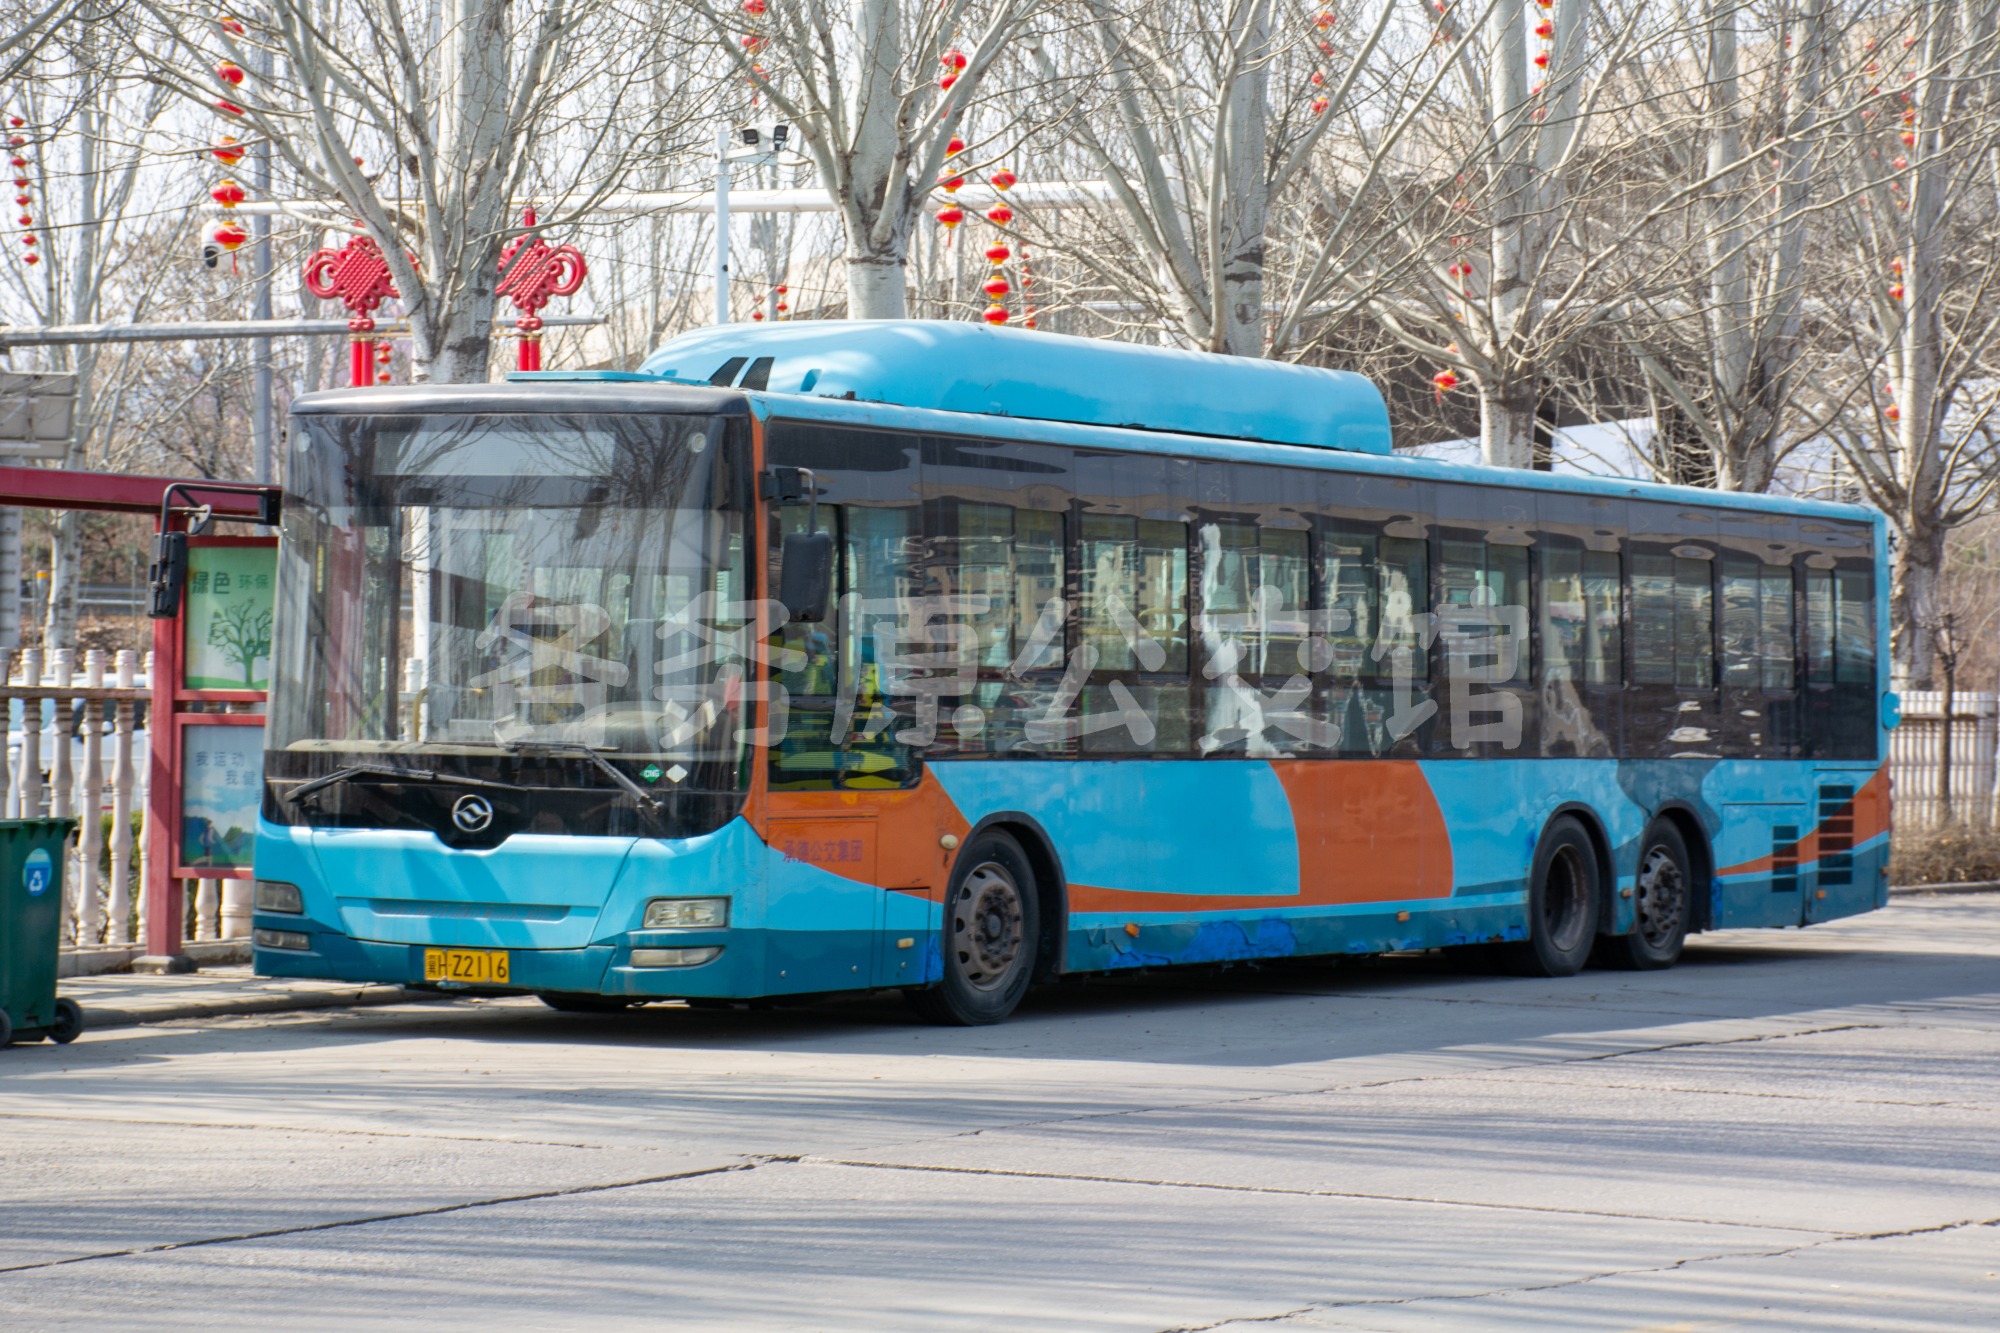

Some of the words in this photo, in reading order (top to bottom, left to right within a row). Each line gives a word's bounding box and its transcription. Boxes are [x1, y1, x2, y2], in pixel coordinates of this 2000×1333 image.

[782, 839, 864, 864] 承德公交集团
